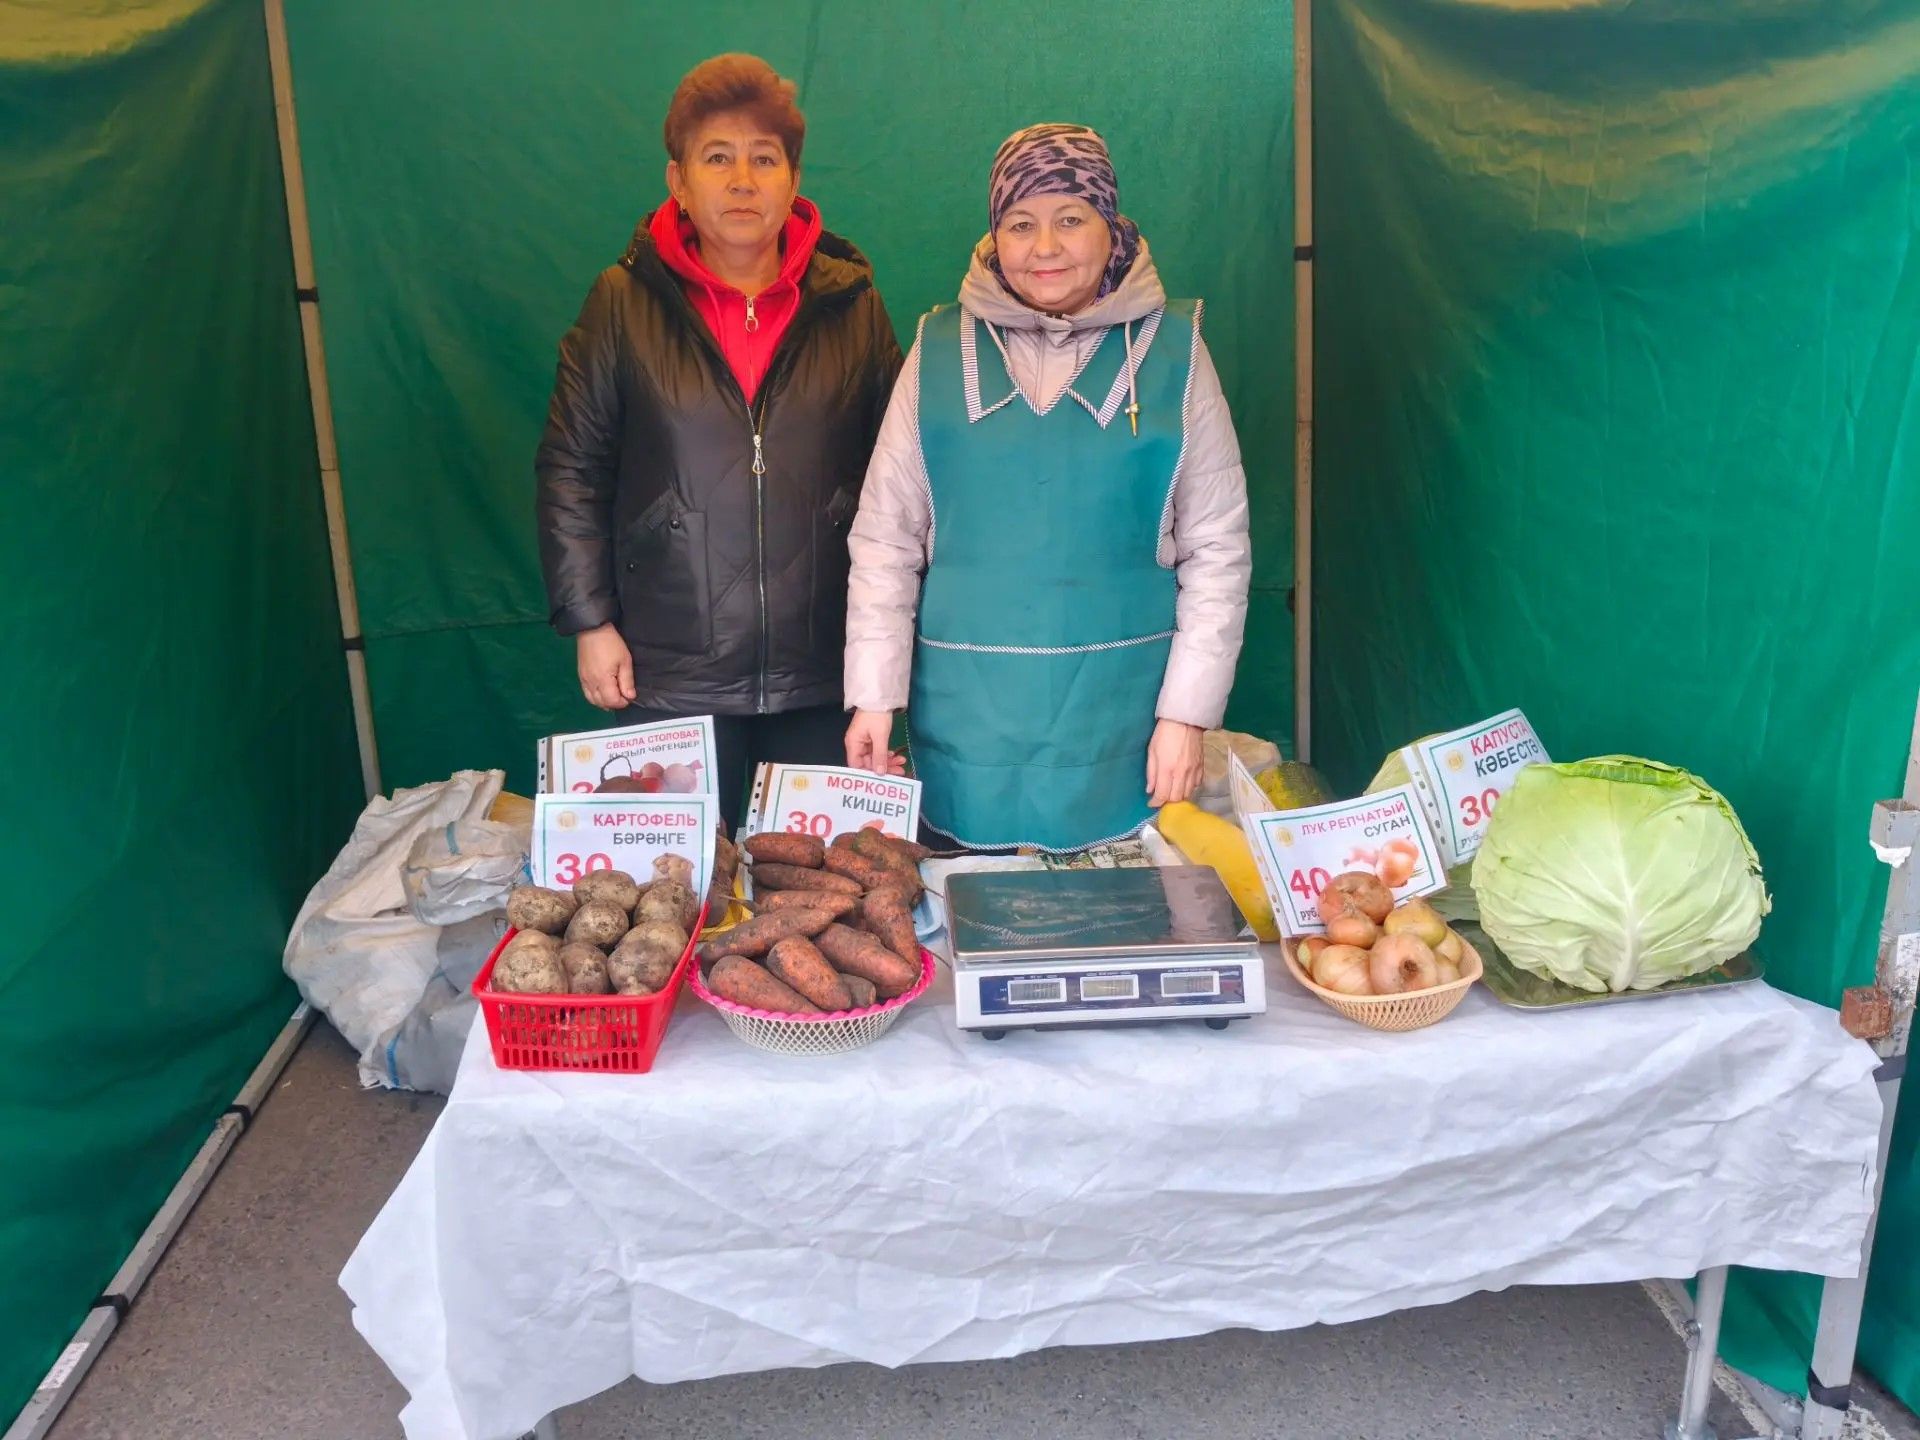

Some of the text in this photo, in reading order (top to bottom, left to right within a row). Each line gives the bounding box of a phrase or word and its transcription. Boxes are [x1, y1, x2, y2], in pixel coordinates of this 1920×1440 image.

[606, 730, 699, 749] СВЕКЛА СТОЛОВАЯ
[1470, 721, 1528, 756] КАПУСТА
[827, 776, 909, 801] МОРКОВЬ
[842, 795, 906, 817] КИШЕР
[1302, 800, 1406, 836] ЛУК РЕПЧАТЫЙ
[1460, 788, 1500, 827] 30
[593, 813, 698, 828] КАРТОФЕЛЬ
[786, 811, 832, 839] 30
[1364, 815, 1411, 838] СУГАН
[613, 832, 687, 847] БӘРӘҢГЕ
[555, 852, 613, 886] 30
[1290, 867, 1332, 900] 40
